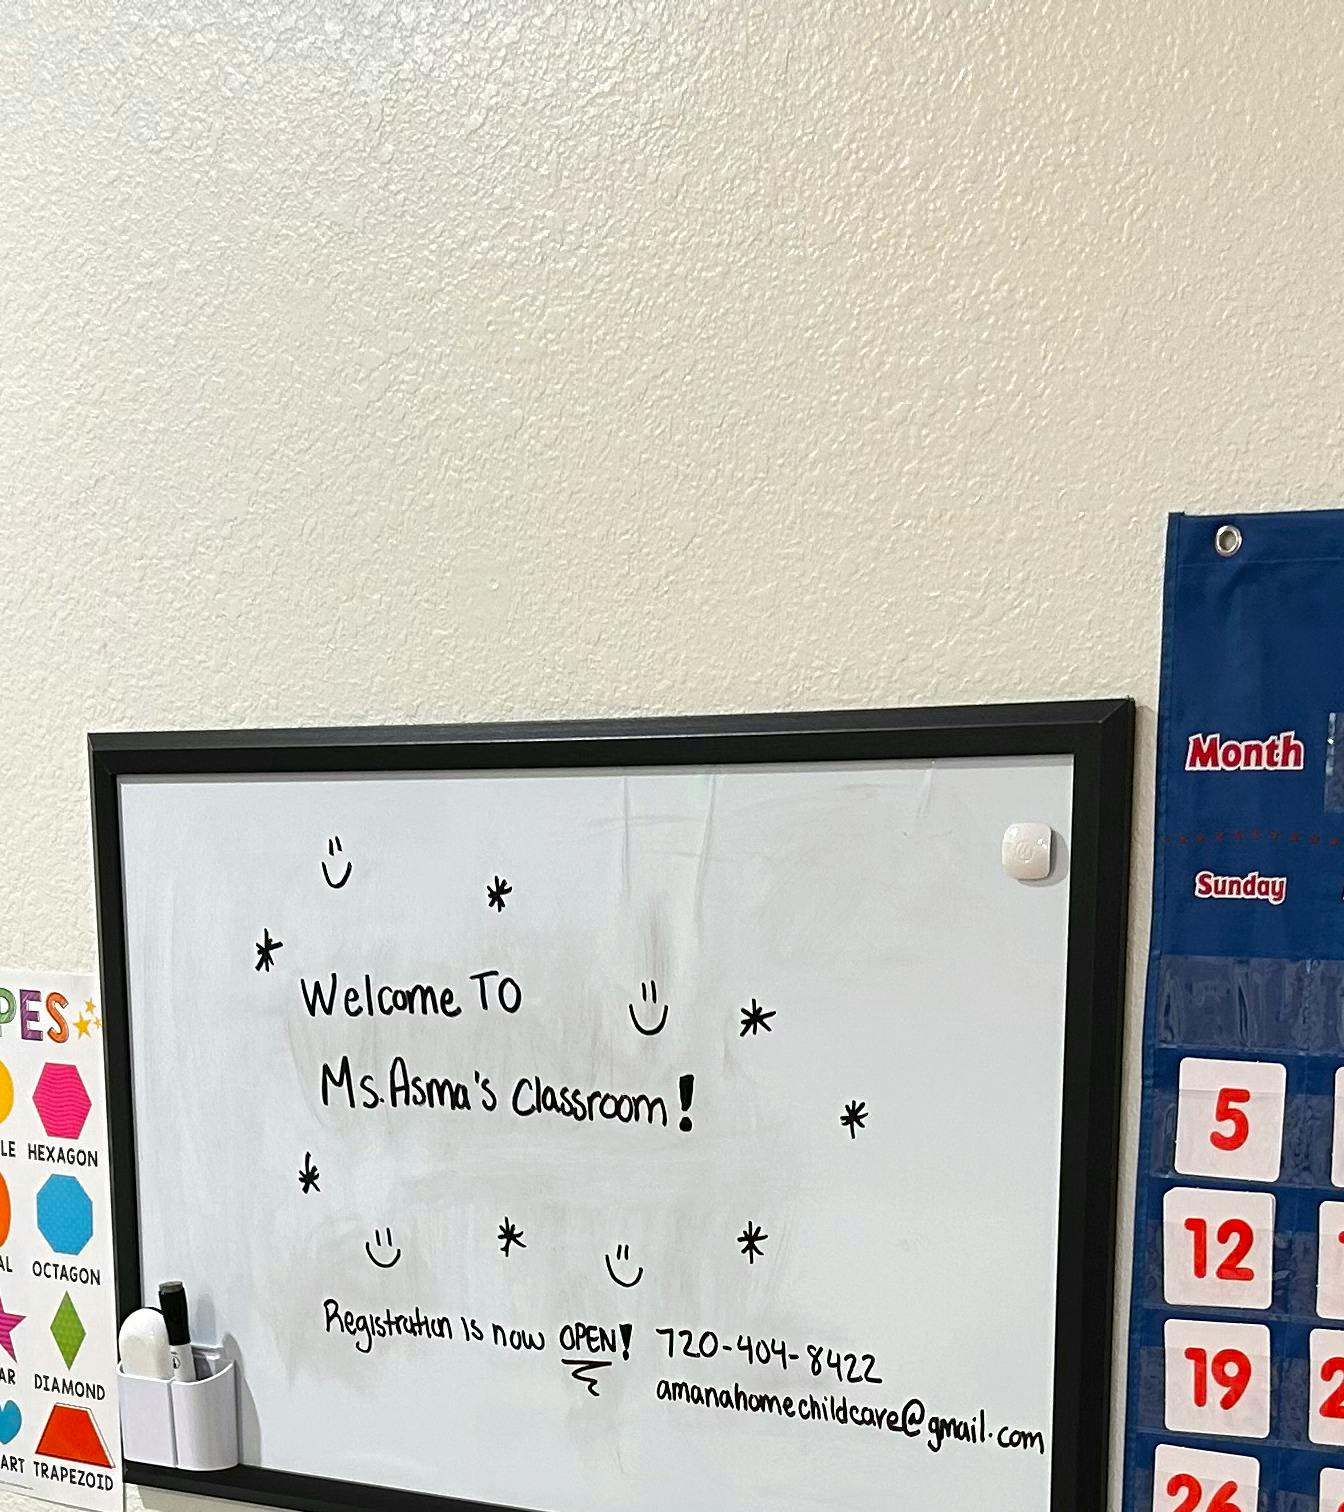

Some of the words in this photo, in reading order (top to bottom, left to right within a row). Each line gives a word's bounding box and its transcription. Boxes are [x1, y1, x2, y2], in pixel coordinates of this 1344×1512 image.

[1185, 730, 1305, 772] Month
[1195, 871, 1287, 904] Sunday
[300, 972, 462, 1018] Welcome
[1210, 1087, 1251, 1152] 5
[27, 1143, 99, 1168] HEXAGON
[32, 1260, 101, 1286] OCTAGON
[1184, 1218, 1256, 1282] 12
[322, 1298, 454, 1355] Registration
[491, 1324, 546, 1353] now
[558, 1322, 632, 1361] OPEN!
[655, 1326, 882, 1385] 720-404-8422
[1184, 1347, 1252, 1410] 19
[34, 1373, 106, 1400] DIAMOND
[656, 1380, 1045, 1454] amanahomechildcare@gmail.com
[33, 1461, 114, 1491] TRAPEZOID
